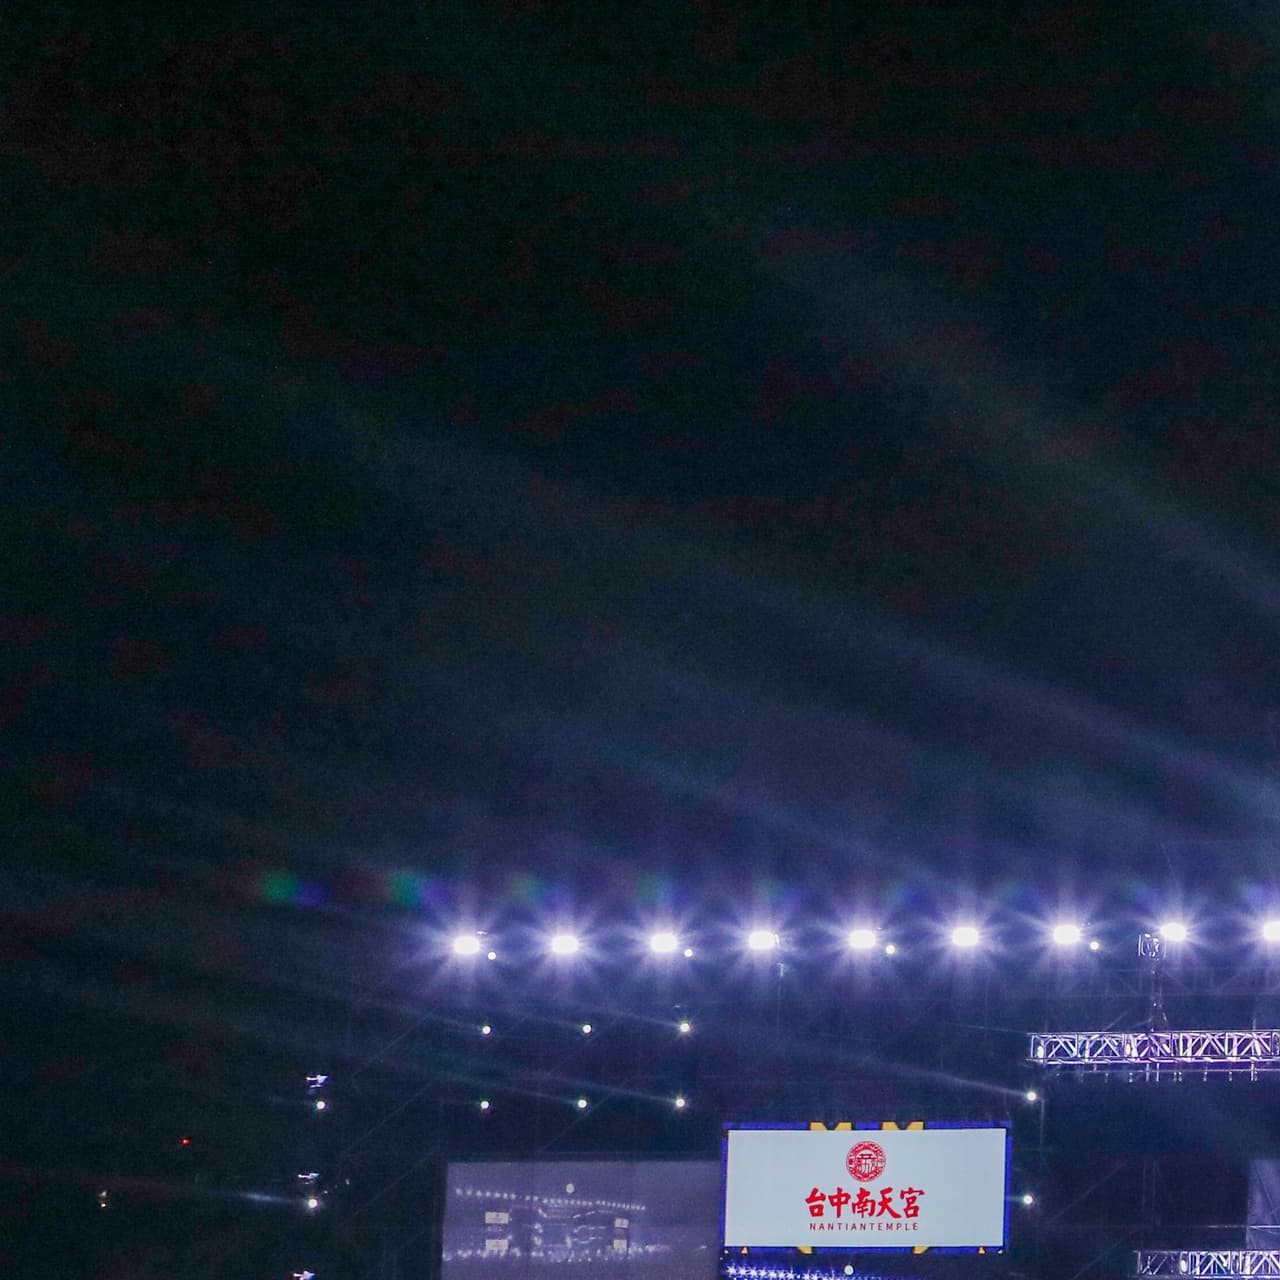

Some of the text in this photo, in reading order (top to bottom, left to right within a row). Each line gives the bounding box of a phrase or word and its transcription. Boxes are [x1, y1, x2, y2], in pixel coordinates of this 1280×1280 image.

[805, 1186, 925, 1219] 台中南天宮
[809, 1222, 919, 1231] NANTIANTEMPLE
